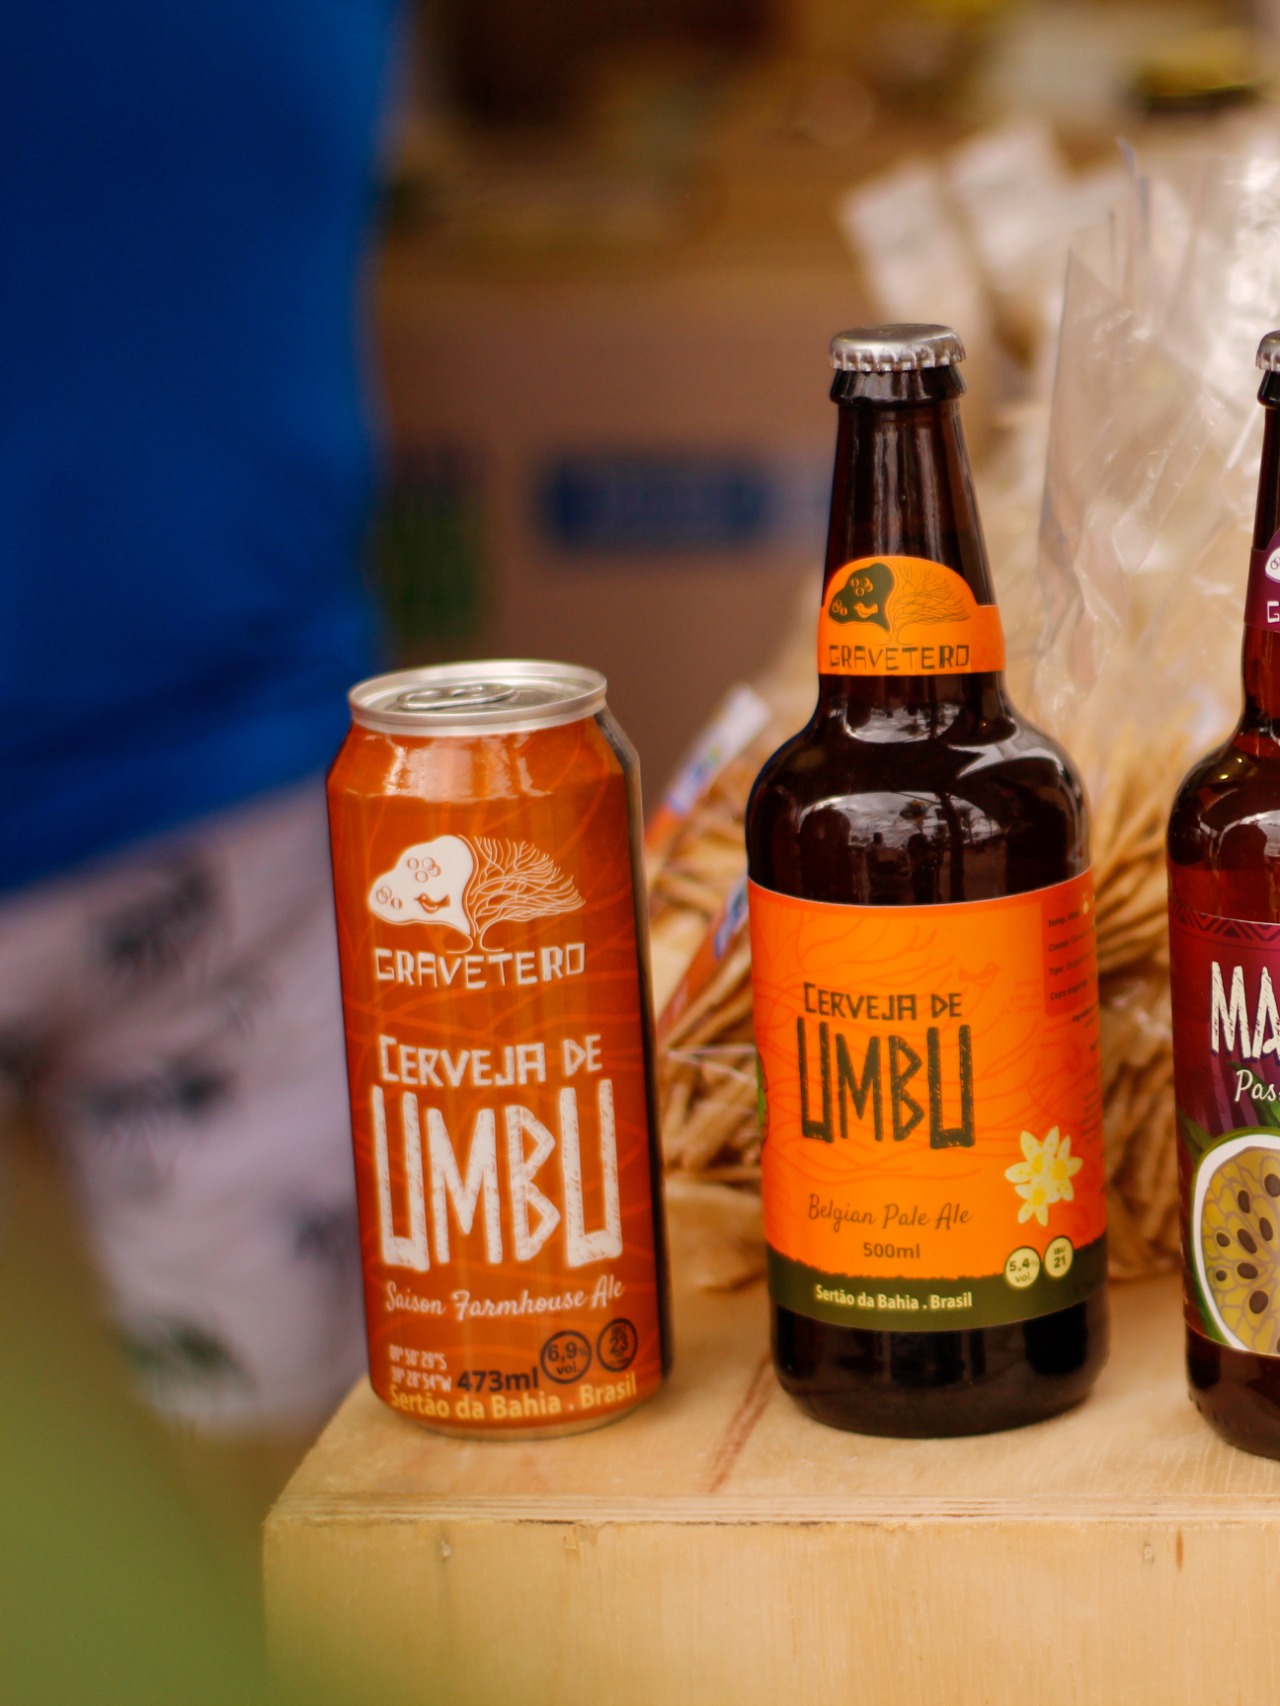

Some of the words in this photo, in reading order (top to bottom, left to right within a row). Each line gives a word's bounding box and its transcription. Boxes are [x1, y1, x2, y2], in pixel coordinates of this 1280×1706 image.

[829, 645, 970, 671] GRAVETERO
[374, 943, 586, 990] GRAVETERO
[803, 981, 918, 1021] CERVEJA
[931, 992, 963, 1018] DE
[379, 1034, 546, 1088] CERVEJA
[563, 1034, 603, 1077] DE
[797, 1016, 976, 1150] UMBU
[372, 1079, 623, 1272] UMBU
[807, 1194, 877, 1233] Belgian
[882, 1204, 930, 1230] Pale
[935, 1202, 974, 1229] Ale
[863, 1241, 921, 1260] 500ml
[1054, 1255, 1066, 1269] 21
[385, 1280, 447, 1317] Saison
[451, 1288, 588, 1321] Farmhouse
[588, 1274, 625, 1309] Ale
[816, 1283, 856, 1307] Sertão
[858, 1291, 876, 1310] da
[878, 1291, 919, 1311] Bahia
[930, 1291, 973, 1310] Brasil
[389, 1385, 449, 1418] Sertão
[455, 1388, 485, 1420] da
[492, 1391, 562, 1419] Bahia
[580, 1371, 637, 1410] Brasil
[457, 1366, 539, 1393] 473ml
